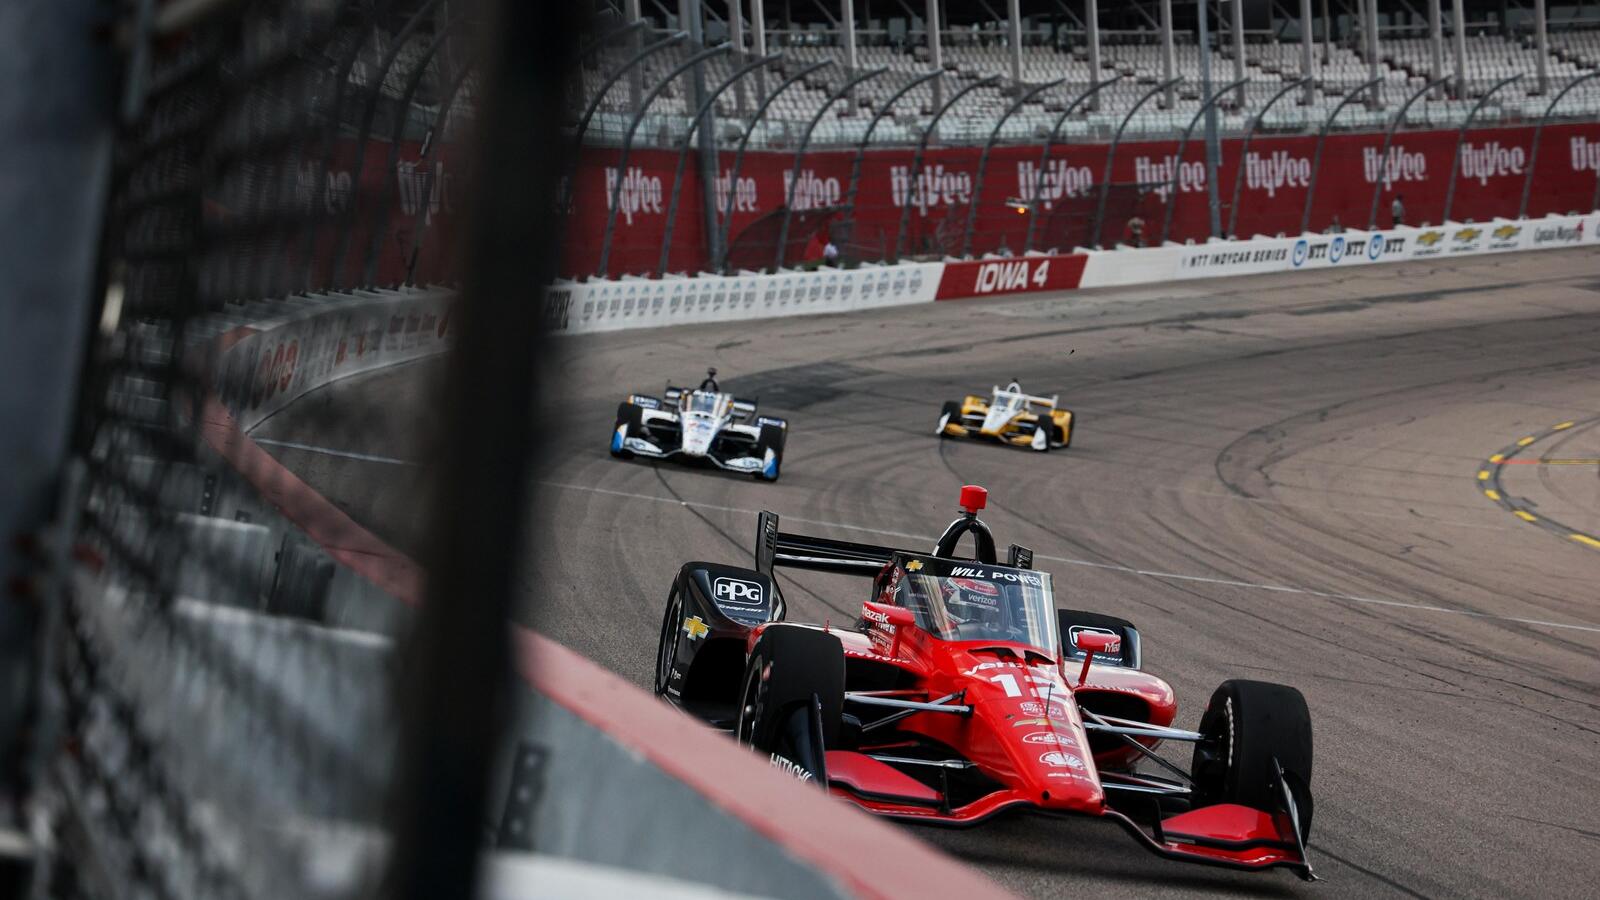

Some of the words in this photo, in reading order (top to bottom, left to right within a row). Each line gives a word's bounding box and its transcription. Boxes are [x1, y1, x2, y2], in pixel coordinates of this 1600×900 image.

[1461, 141, 1526, 186] HyVee
[1245, 150, 1312, 197] HyVee
[1308, 243, 1329, 259] NTT
[1345, 240, 1367, 256] NTT
[1385, 238, 1406, 253] NTT
[1189, 254, 1209, 268] NTT
[1211, 251, 1251, 266] INDYCAR
[1252, 248, 1288, 263] SERIES
[974, 261, 1029, 293] IOWA
[1033, 260, 1051, 287] 4
[951, 566, 985, 579] WILL
[717, 581, 760, 601] PPG
[968, 593, 997, 606] verizon
[862, 606, 890, 623] Mazak
